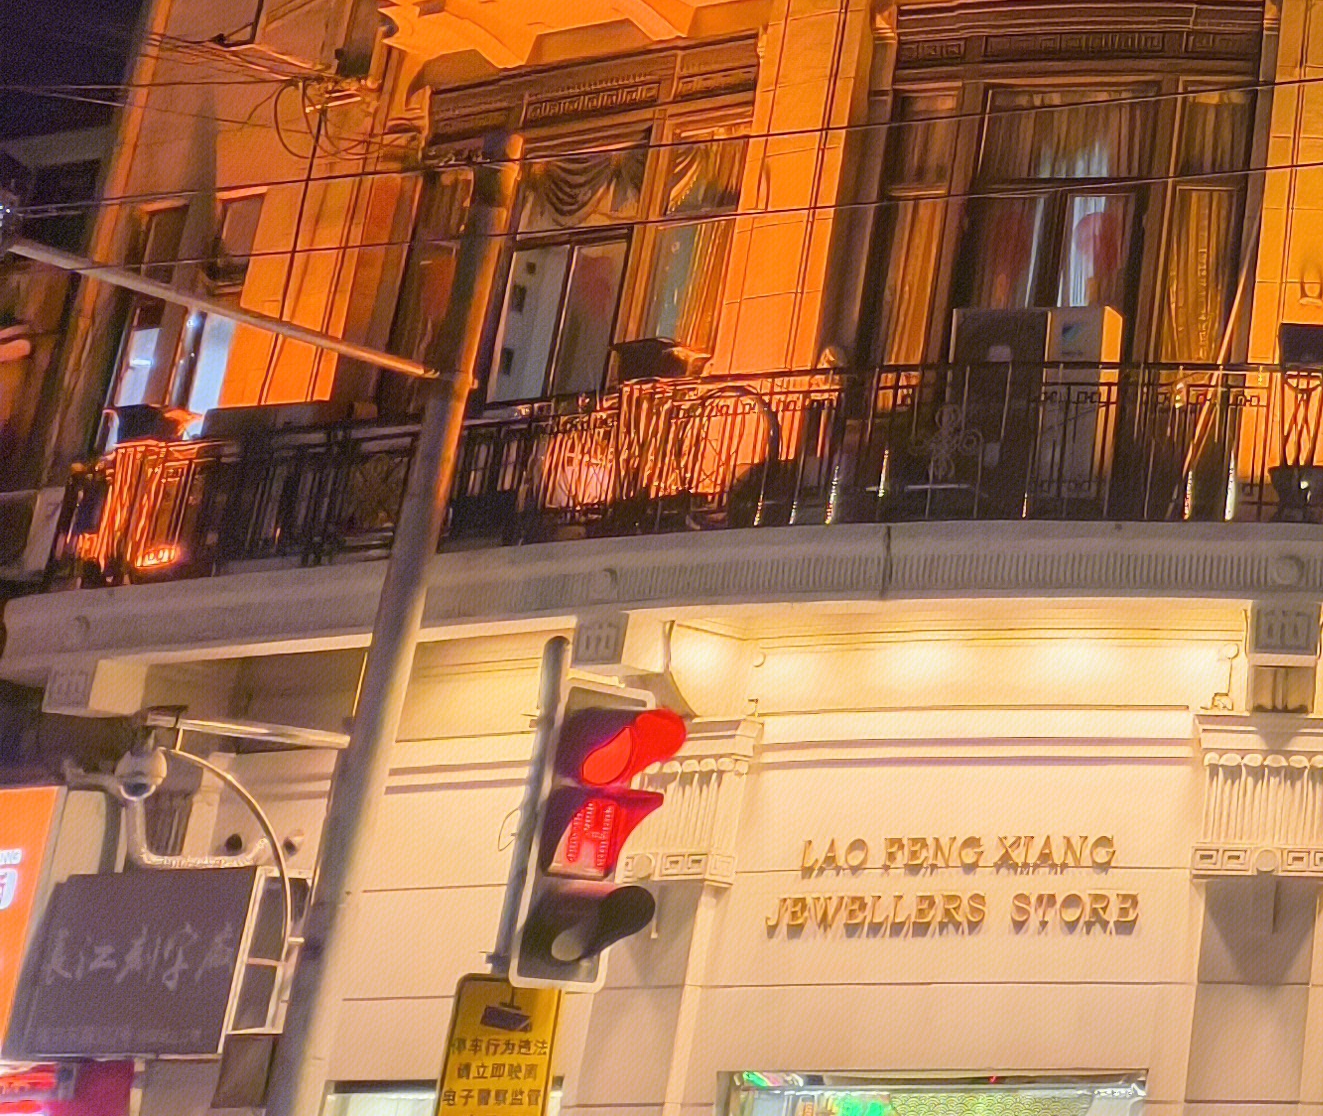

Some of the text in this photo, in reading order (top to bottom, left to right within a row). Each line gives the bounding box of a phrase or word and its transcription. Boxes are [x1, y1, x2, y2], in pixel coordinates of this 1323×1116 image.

[801, 835, 1116, 871] LAO FENG XIANG
[766, 892, 1140, 927] JEWELLERS STORE
